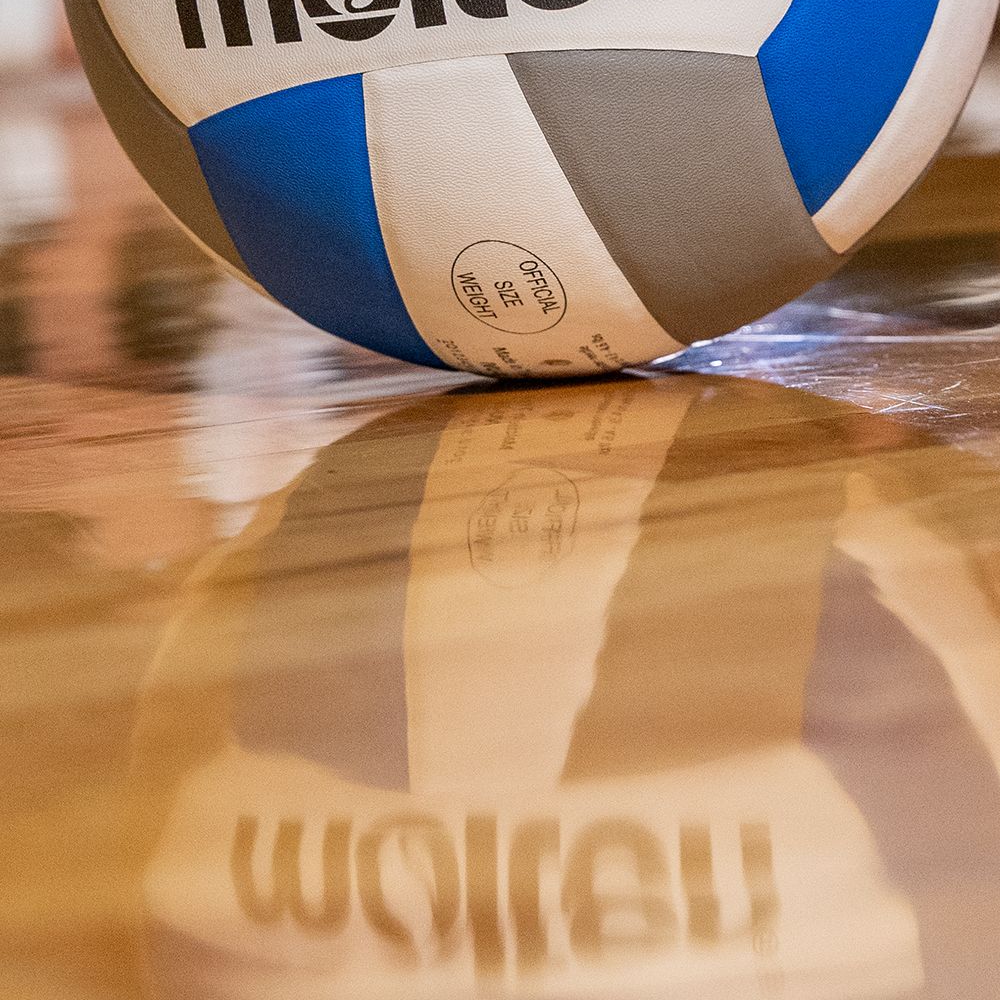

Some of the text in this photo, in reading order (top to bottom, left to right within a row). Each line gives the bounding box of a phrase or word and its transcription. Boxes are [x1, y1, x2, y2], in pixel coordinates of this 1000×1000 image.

[457, 272, 497, 319] WEIGHT
[494, 280, 524, 307] SIZE
[519, 260, 560, 314] OFFICIAL
